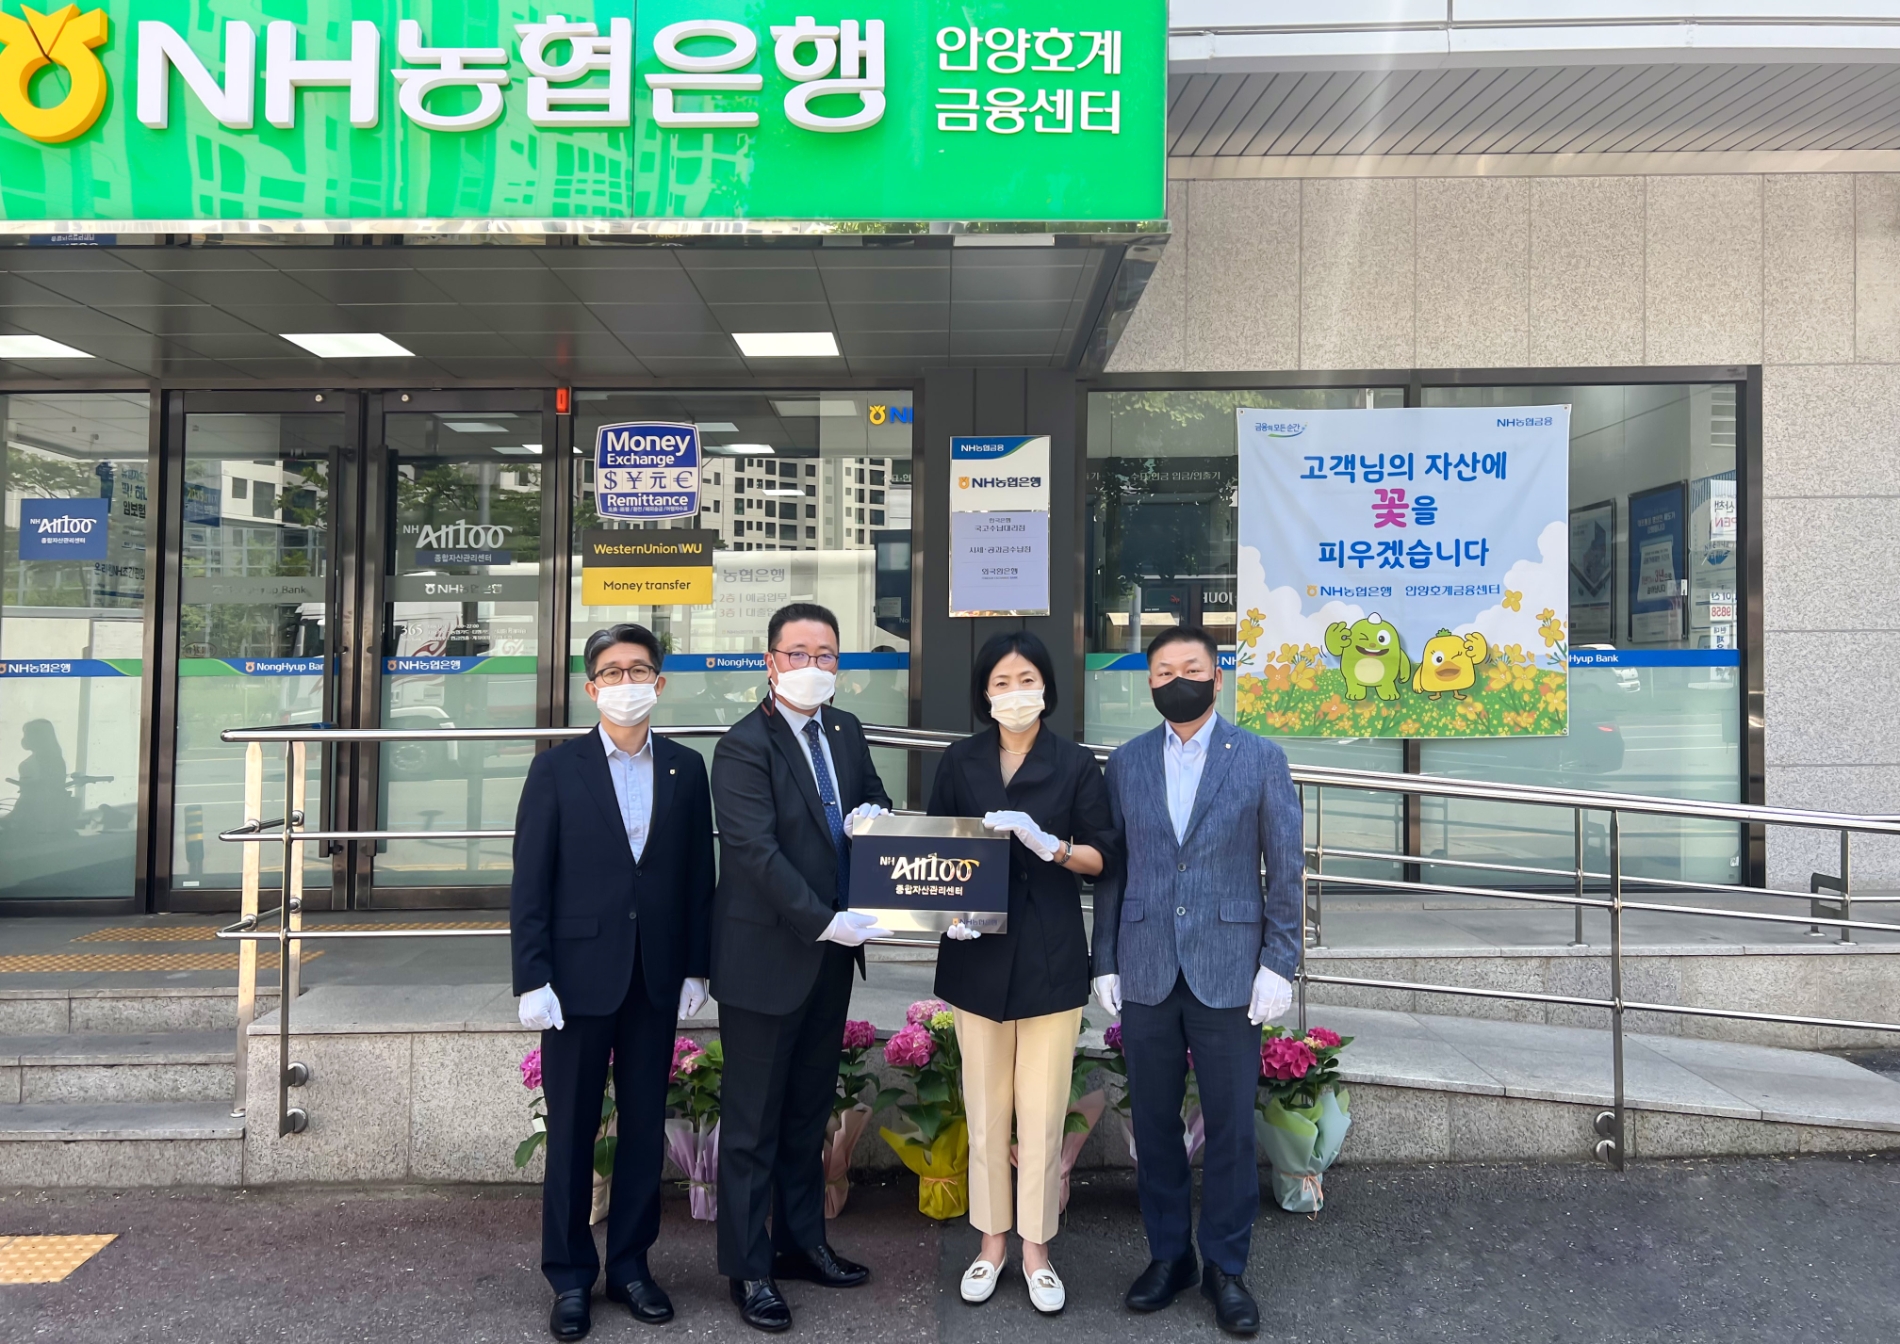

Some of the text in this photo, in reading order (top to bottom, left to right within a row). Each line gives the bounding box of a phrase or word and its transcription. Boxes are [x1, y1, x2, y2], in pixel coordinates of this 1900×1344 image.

[936, 27, 1122, 75] 안양호계
[136, 15, 886, 133] NH농협은행
[935, 87, 1122, 135] 금융센터
[1497, 416, 1553, 428] NH농협금융
[607, 431, 690, 456] Money
[961, 444, 1004, 452] NH농협금융
[607, 453, 674, 467] Exchange
[1300, 451, 1507, 484] 고객님의 자산에
[972, 476, 1042, 488] NH농협은행
[607, 493, 688, 506] Remittance
[1371, 488, 1438, 528] 꽃을
[403, 525, 419, 534] NH
[434, 554, 492, 562] 종합자산관리센터
[1318, 538, 1490, 569] 피우겠습니다
[723, 568, 785, 583] 농협은행
[282, 586, 306, 594] Bank
[604, 580, 691, 592] Money transfer
[1320, 584, 1500, 597] NH농협은행 안양호계금융센터
[717, 658, 765, 668] NongHyup
[1596, 654, 1619, 663] Bank
[9, 662, 71, 673] NH농협은행
[257, 663, 306, 672] NongHyup
[399, 660, 460, 671] NH농협은행
[880, 856, 895, 866] NH
[896, 885, 963, 896] 종합자산관리센터
